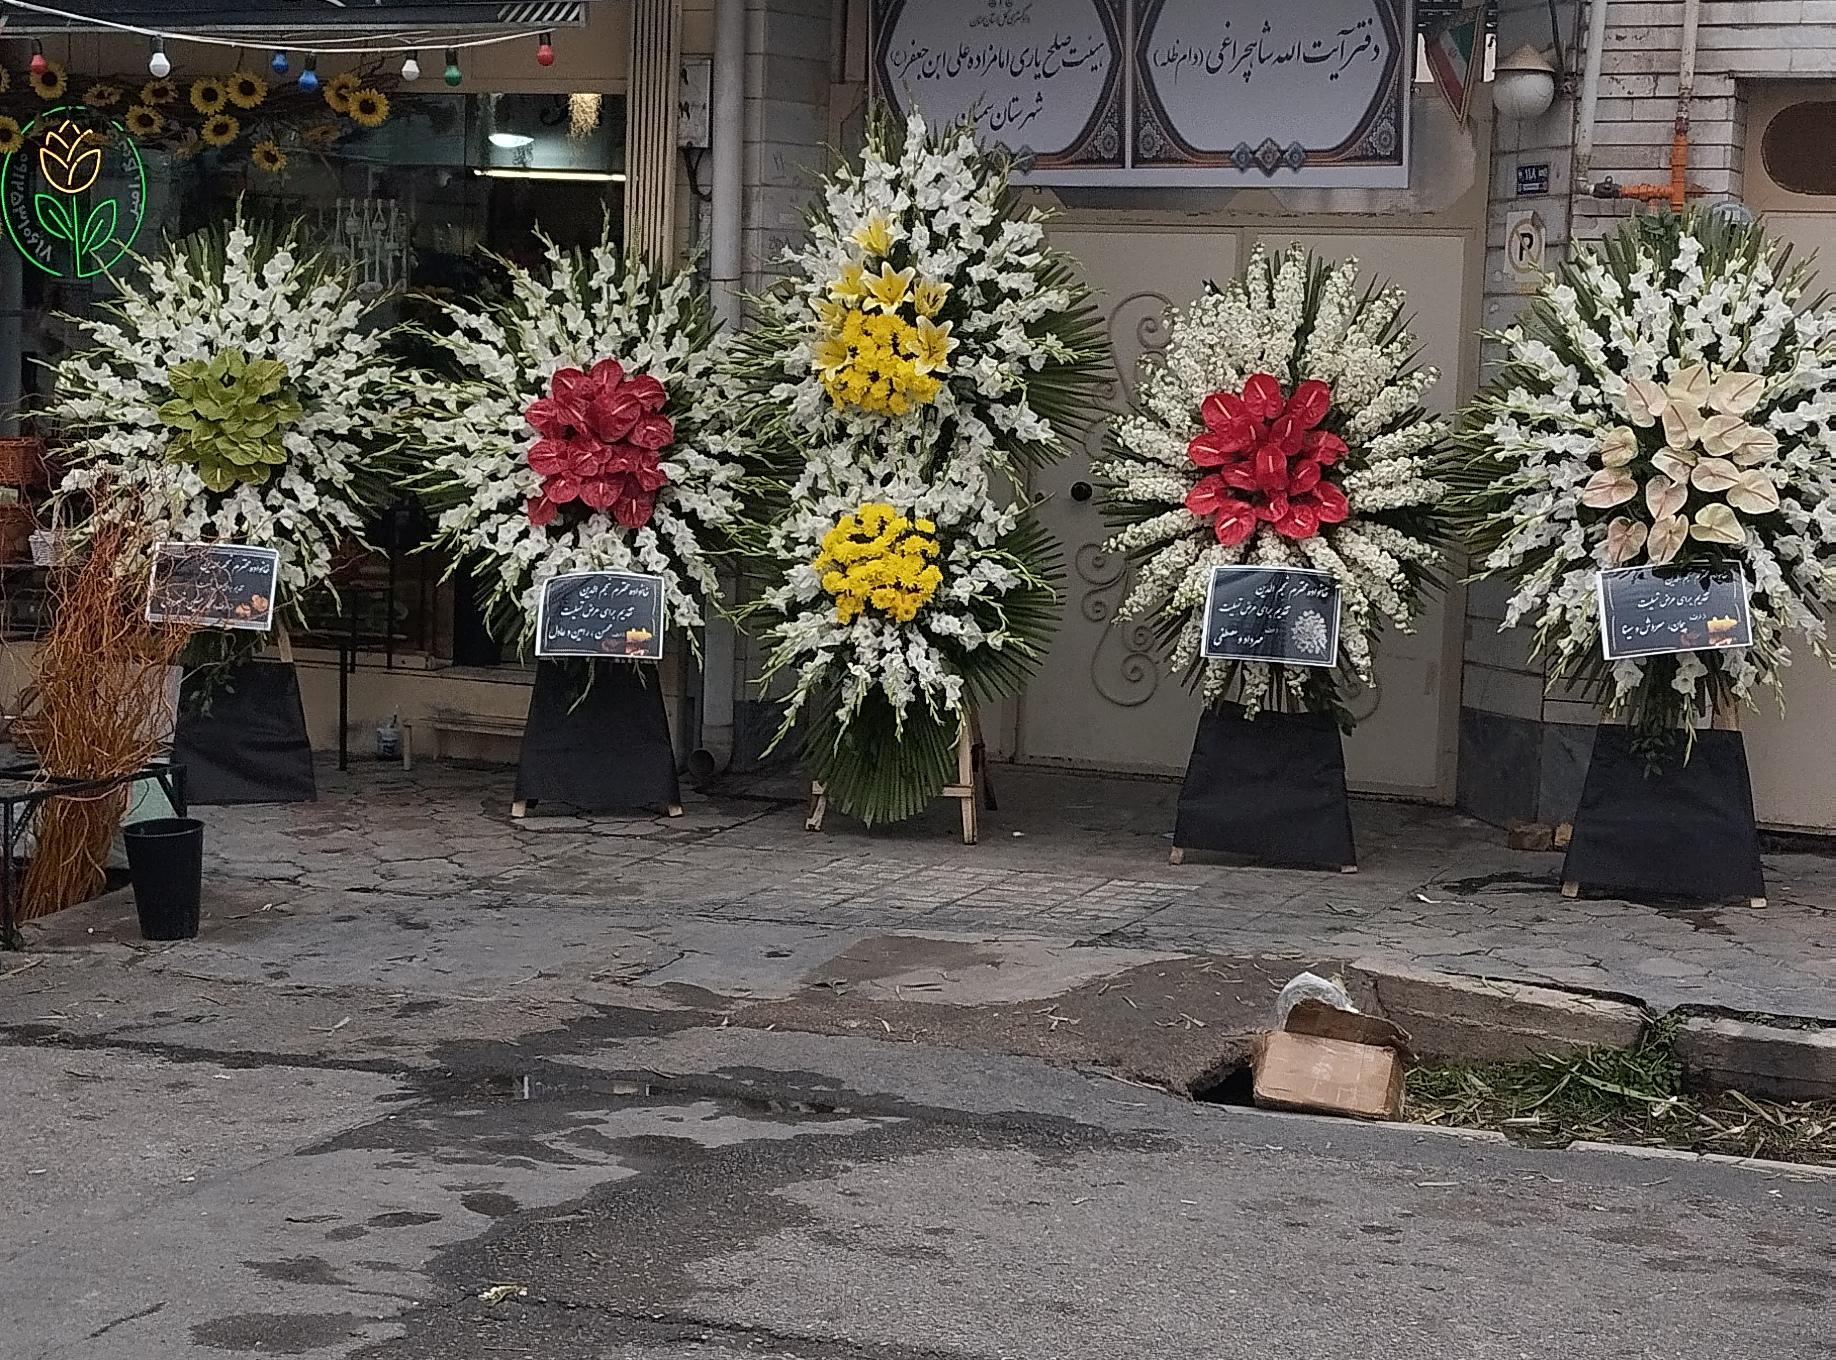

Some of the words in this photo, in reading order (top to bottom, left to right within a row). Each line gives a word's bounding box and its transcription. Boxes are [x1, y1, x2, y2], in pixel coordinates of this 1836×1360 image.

[1153, 39, 1179, 67] ظله)
[1205, 20, 1274, 83] شاهچراغی
[1271, 40, 1302, 65] الله
[1302, 27, 1354, 81] آیت
[1339, 18, 1381, 71] دفتر
[898, 39, 929, 80] جعفر
[922, 51, 946, 80] ابن
[947, 42, 970, 78] علی
[1010, 47, 1041, 80] یاری
[1175, 47, 1204, 84] (دام
[989, 92, 1043, 132] شهرستان
[1519, 233, 1534, 262] P
[599, 577, 612, 599] نجم
[611, 581, 631, 598] محترم
[629, 583, 650, 597] خانواده
[1255, 583, 1275, 598] الدین
[1288, 580, 1309, 600] محترم
[1218, 597, 1244, 617] تسلیت
[1638, 592, 1660, 611] تسلیت
[1677, 595, 1693, 606] برای
[1694, 592, 1710, 607] تقدیم
[560, 601, 585, 620] تسلیت
[600, 607, 617, 620] برای
[617, 606, 635, 620] تقدیم
[1256, 605, 1273, 619] برای
[1273, 605, 1291, 619] تقدیم
[566, 629, 571, 637] و
[570, 627, 590, 641] رامین
[1639, 616, 1665, 636] سروش
